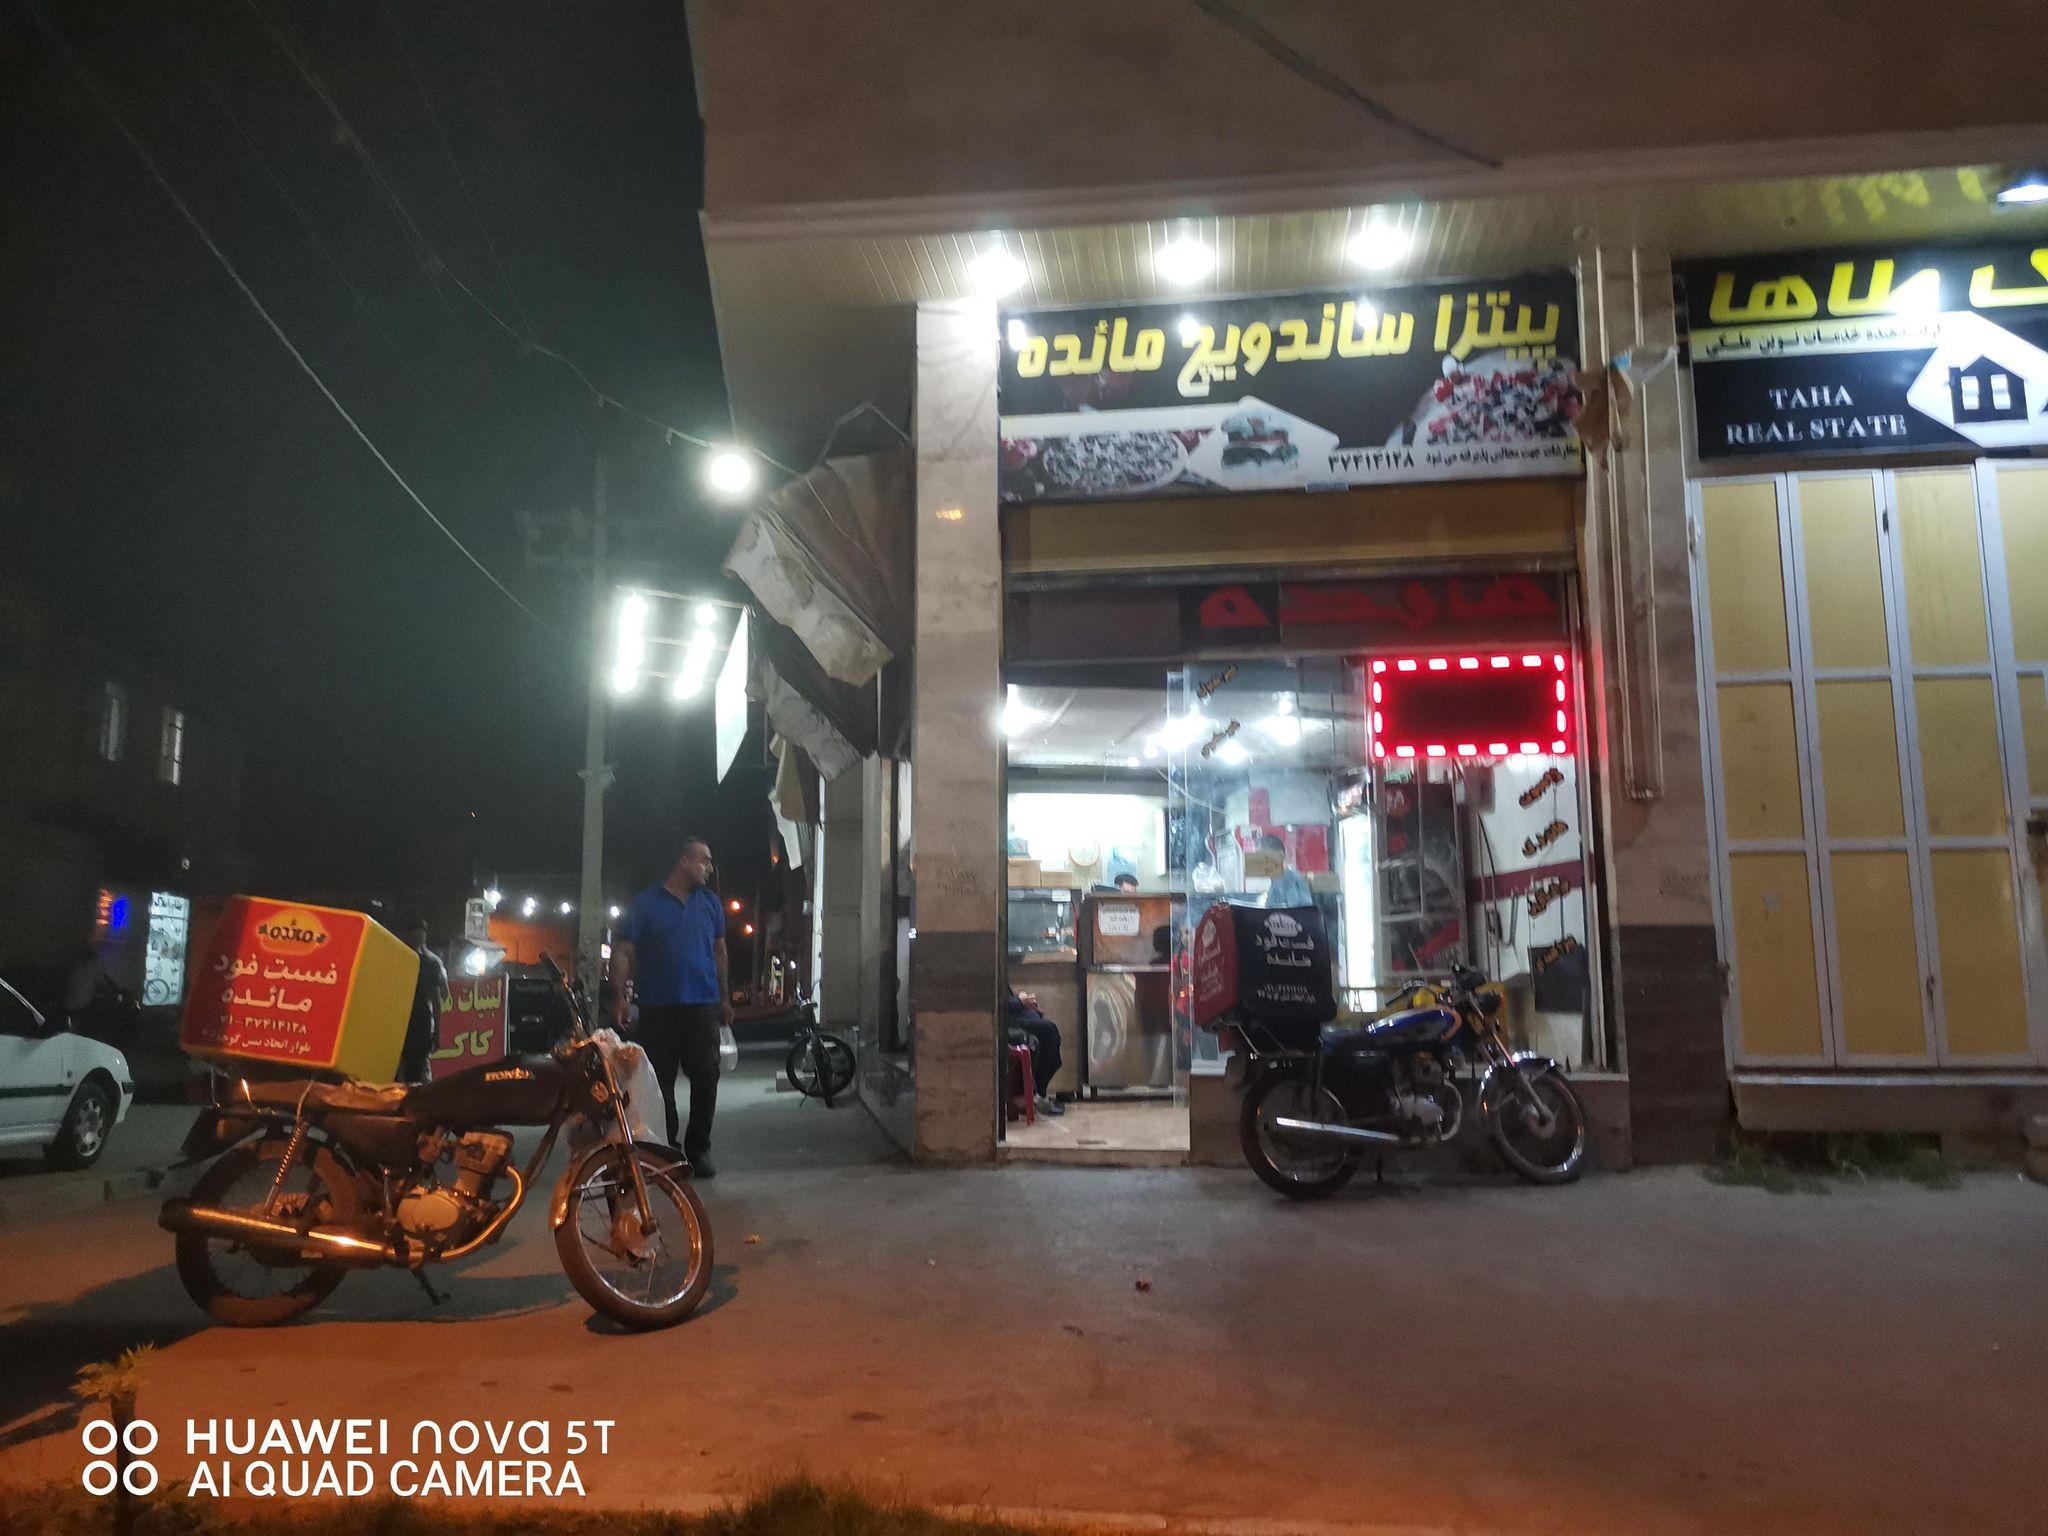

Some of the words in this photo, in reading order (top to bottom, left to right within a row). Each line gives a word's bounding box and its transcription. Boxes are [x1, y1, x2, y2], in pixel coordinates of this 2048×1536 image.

[1017, 316, 1166, 379] مائده
[1177, 300, 1414, 398] ساندویچ
[1433, 290, 1560, 361] پیتزا
[1768, 385, 1854, 410] TAHA
[1727, 421, 1803, 446] REAL
[1809, 414, 1908, 440] STATE
[263, 958, 338, 985] فست
